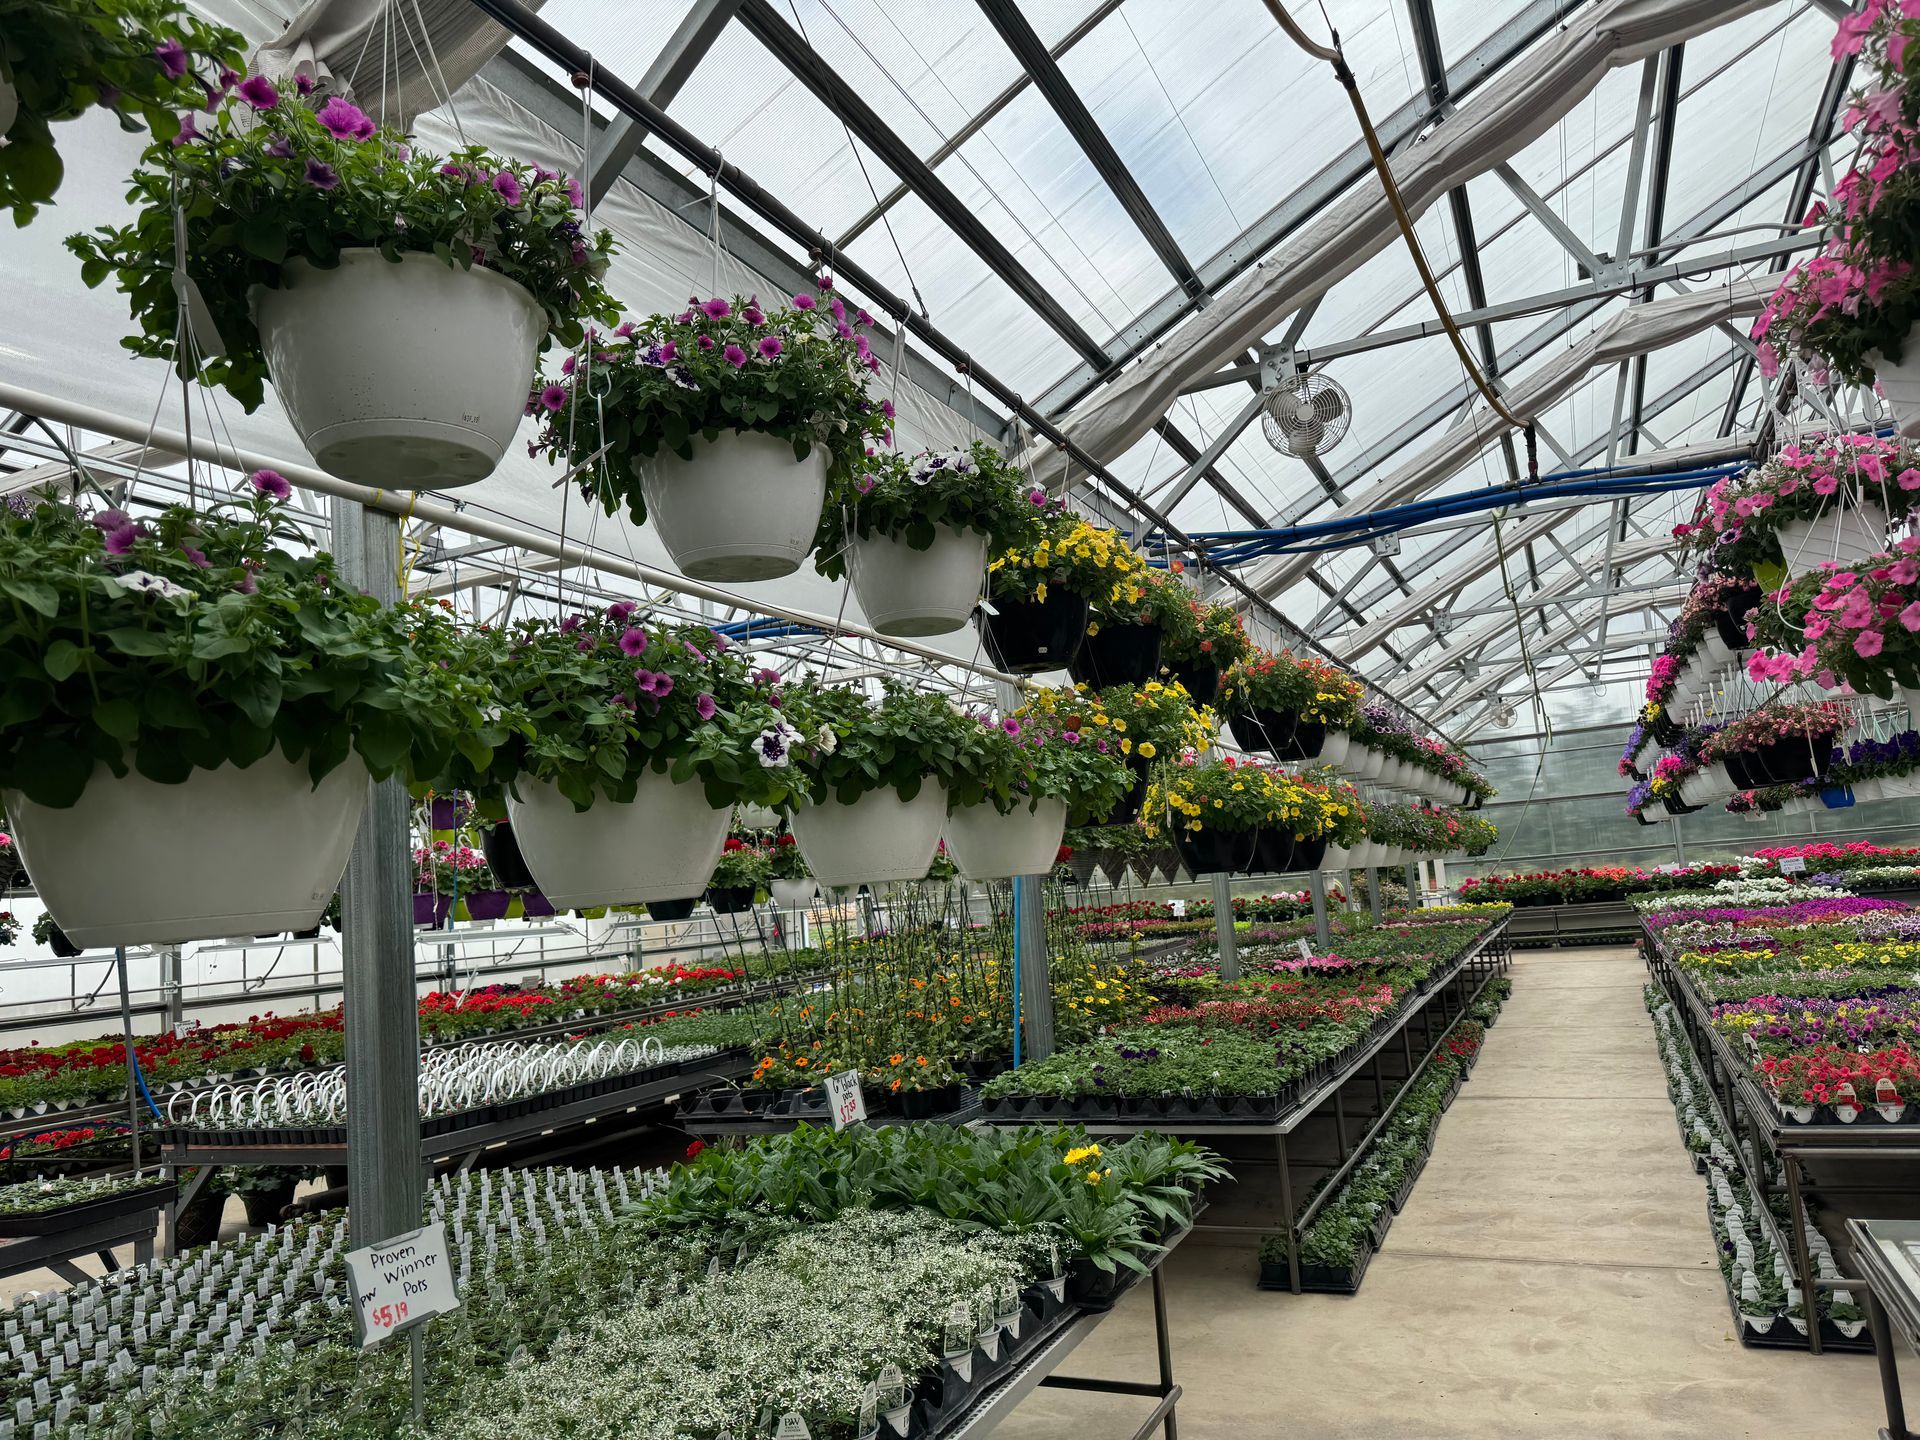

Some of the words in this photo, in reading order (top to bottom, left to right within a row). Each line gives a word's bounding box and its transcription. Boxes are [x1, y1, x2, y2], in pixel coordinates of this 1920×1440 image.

[370, 1245, 416, 1269] Proven
[383, 1253, 438, 1284] Winner
[403, 1279, 428, 1297] Pots
[372, 1301, 409, 1328] $5.19
